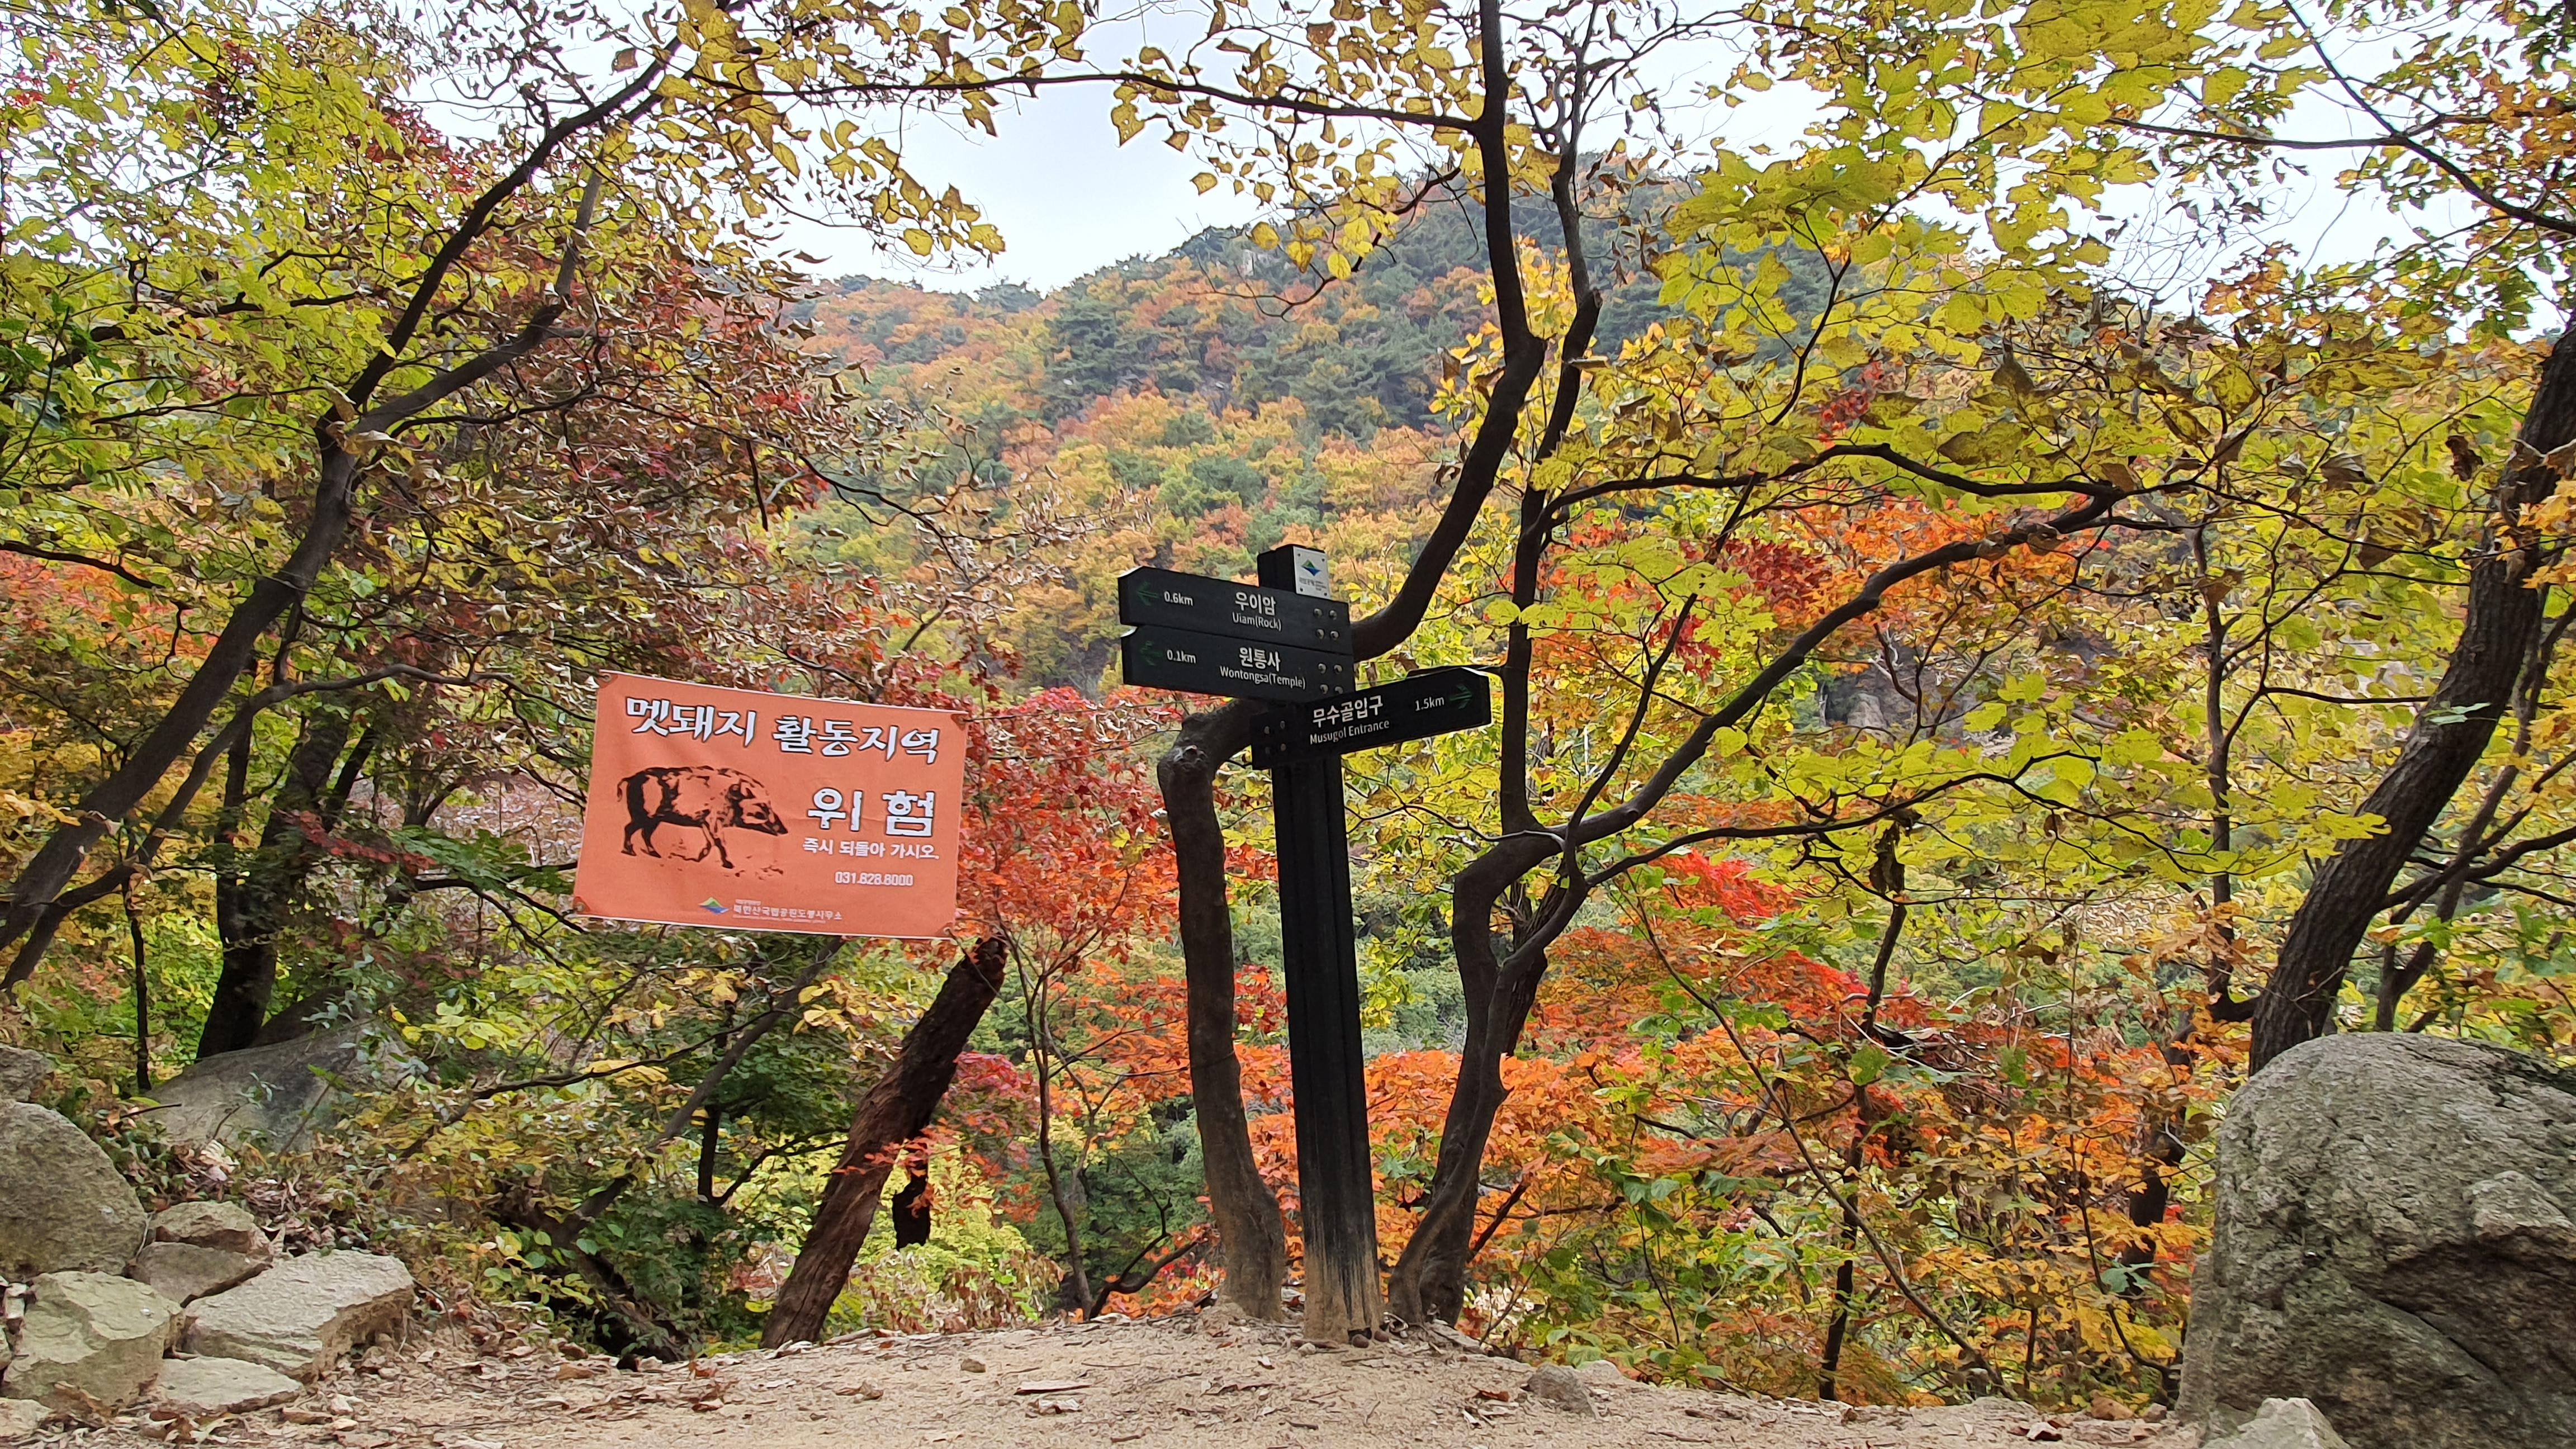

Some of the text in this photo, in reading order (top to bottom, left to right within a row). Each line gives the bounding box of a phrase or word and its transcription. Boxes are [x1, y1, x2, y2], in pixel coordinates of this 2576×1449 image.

[1163, 590, 1194, 606] 0.6km
[1234, 591, 1276, 616] 우이암
[1232, 612, 1282, 631] Uiam(Rock)
[1167, 650, 1196, 664] 0.1km
[1239, 647, 1281, 672] 원통사
[1219, 665, 1306, 689] Wontongsa(Temple)
[1313, 695, 1384, 728] 무수골입구
[1415, 697, 1445, 712] 1.5km
[626, 696, 940, 765] 멧돼지 활동지역
[1309, 719, 1390, 745] Musugol Entrance
[802, 837, 940, 860] 즉시 되돌아 가시오.
[835, 871, 914, 887] 031.828.8000
